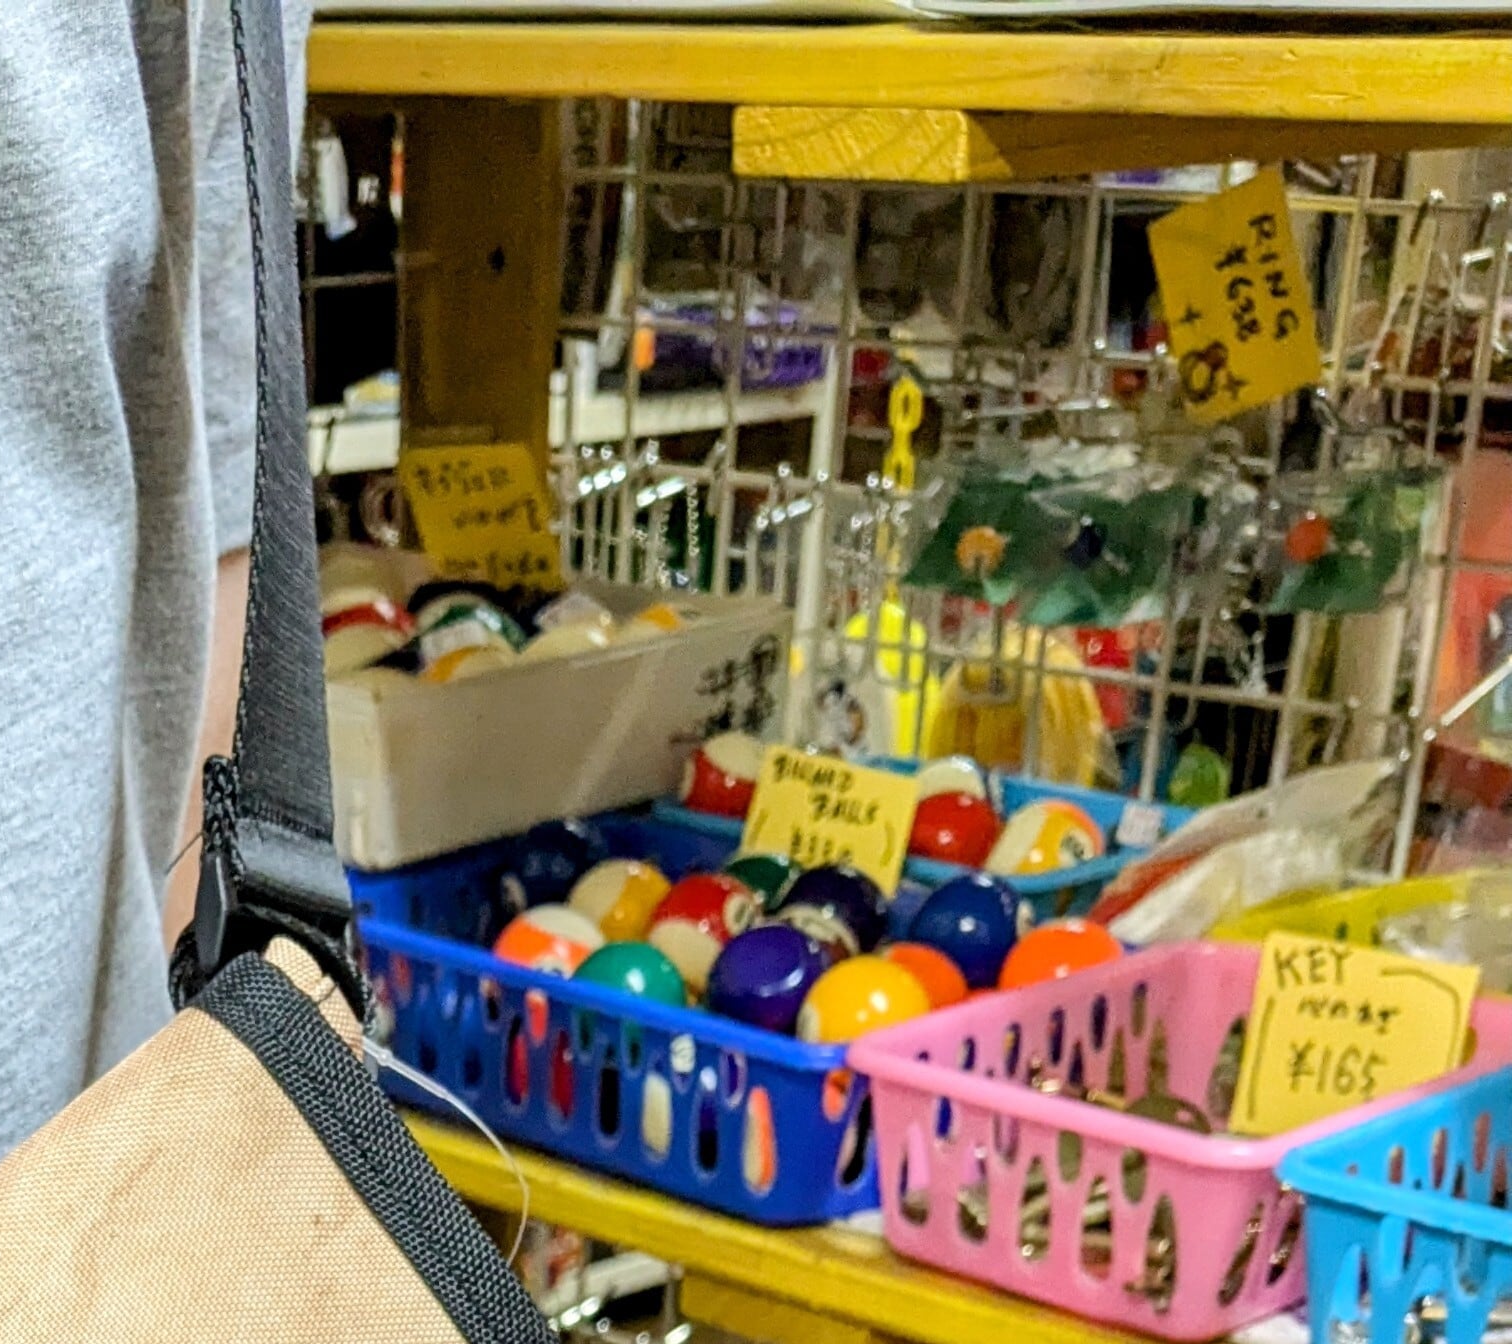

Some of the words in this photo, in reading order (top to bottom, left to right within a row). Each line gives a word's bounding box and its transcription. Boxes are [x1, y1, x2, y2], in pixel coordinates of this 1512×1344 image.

[1248, 213, 1299, 340] RING
[1274, 946, 1354, 990] KEY
[1289, 1040, 1388, 1102] ¥165
